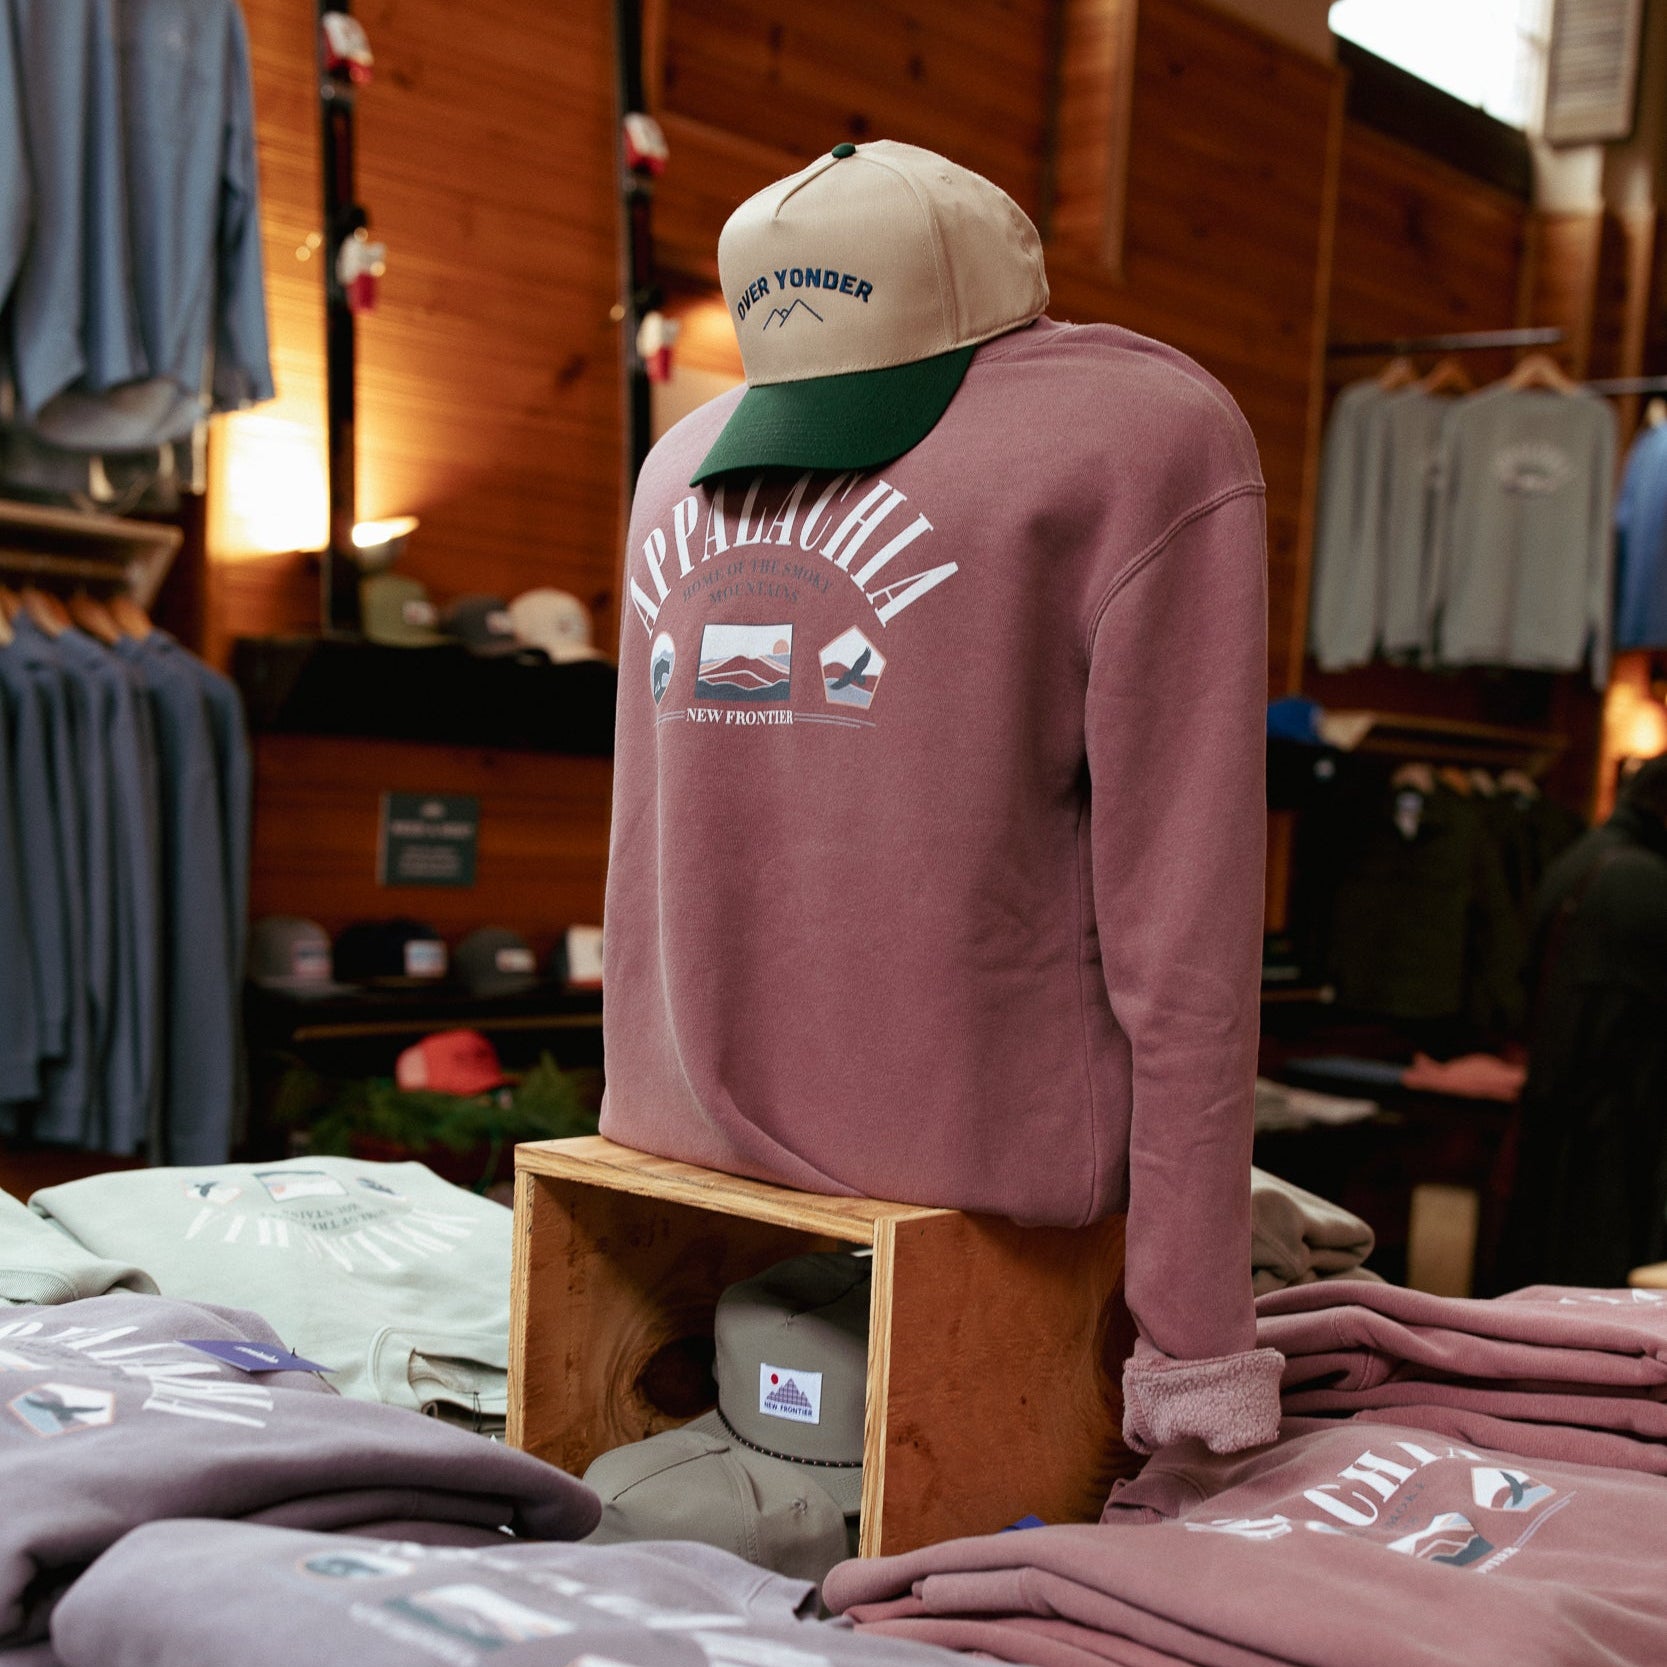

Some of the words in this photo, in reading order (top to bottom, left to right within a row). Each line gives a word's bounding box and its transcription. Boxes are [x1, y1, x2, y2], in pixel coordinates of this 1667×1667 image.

[737, 276, 770, 321] OVER
[774, 267, 873, 303] YONDER
[630, 470, 958, 640] APPALACHIA
[682, 567, 724, 602] HOME
[727, 560, 745, 577] OF
[751, 558, 778, 575] THE
[782, 562, 832, 594] SMOKY
[709, 580, 799, 604] MOUNTAINS
[686, 707, 722, 723] NEW
[725, 709, 794, 725] FRONTIER
[764, 1400, 778, 1411] NEW
[780, 1405, 813, 1417] FRONTIER
